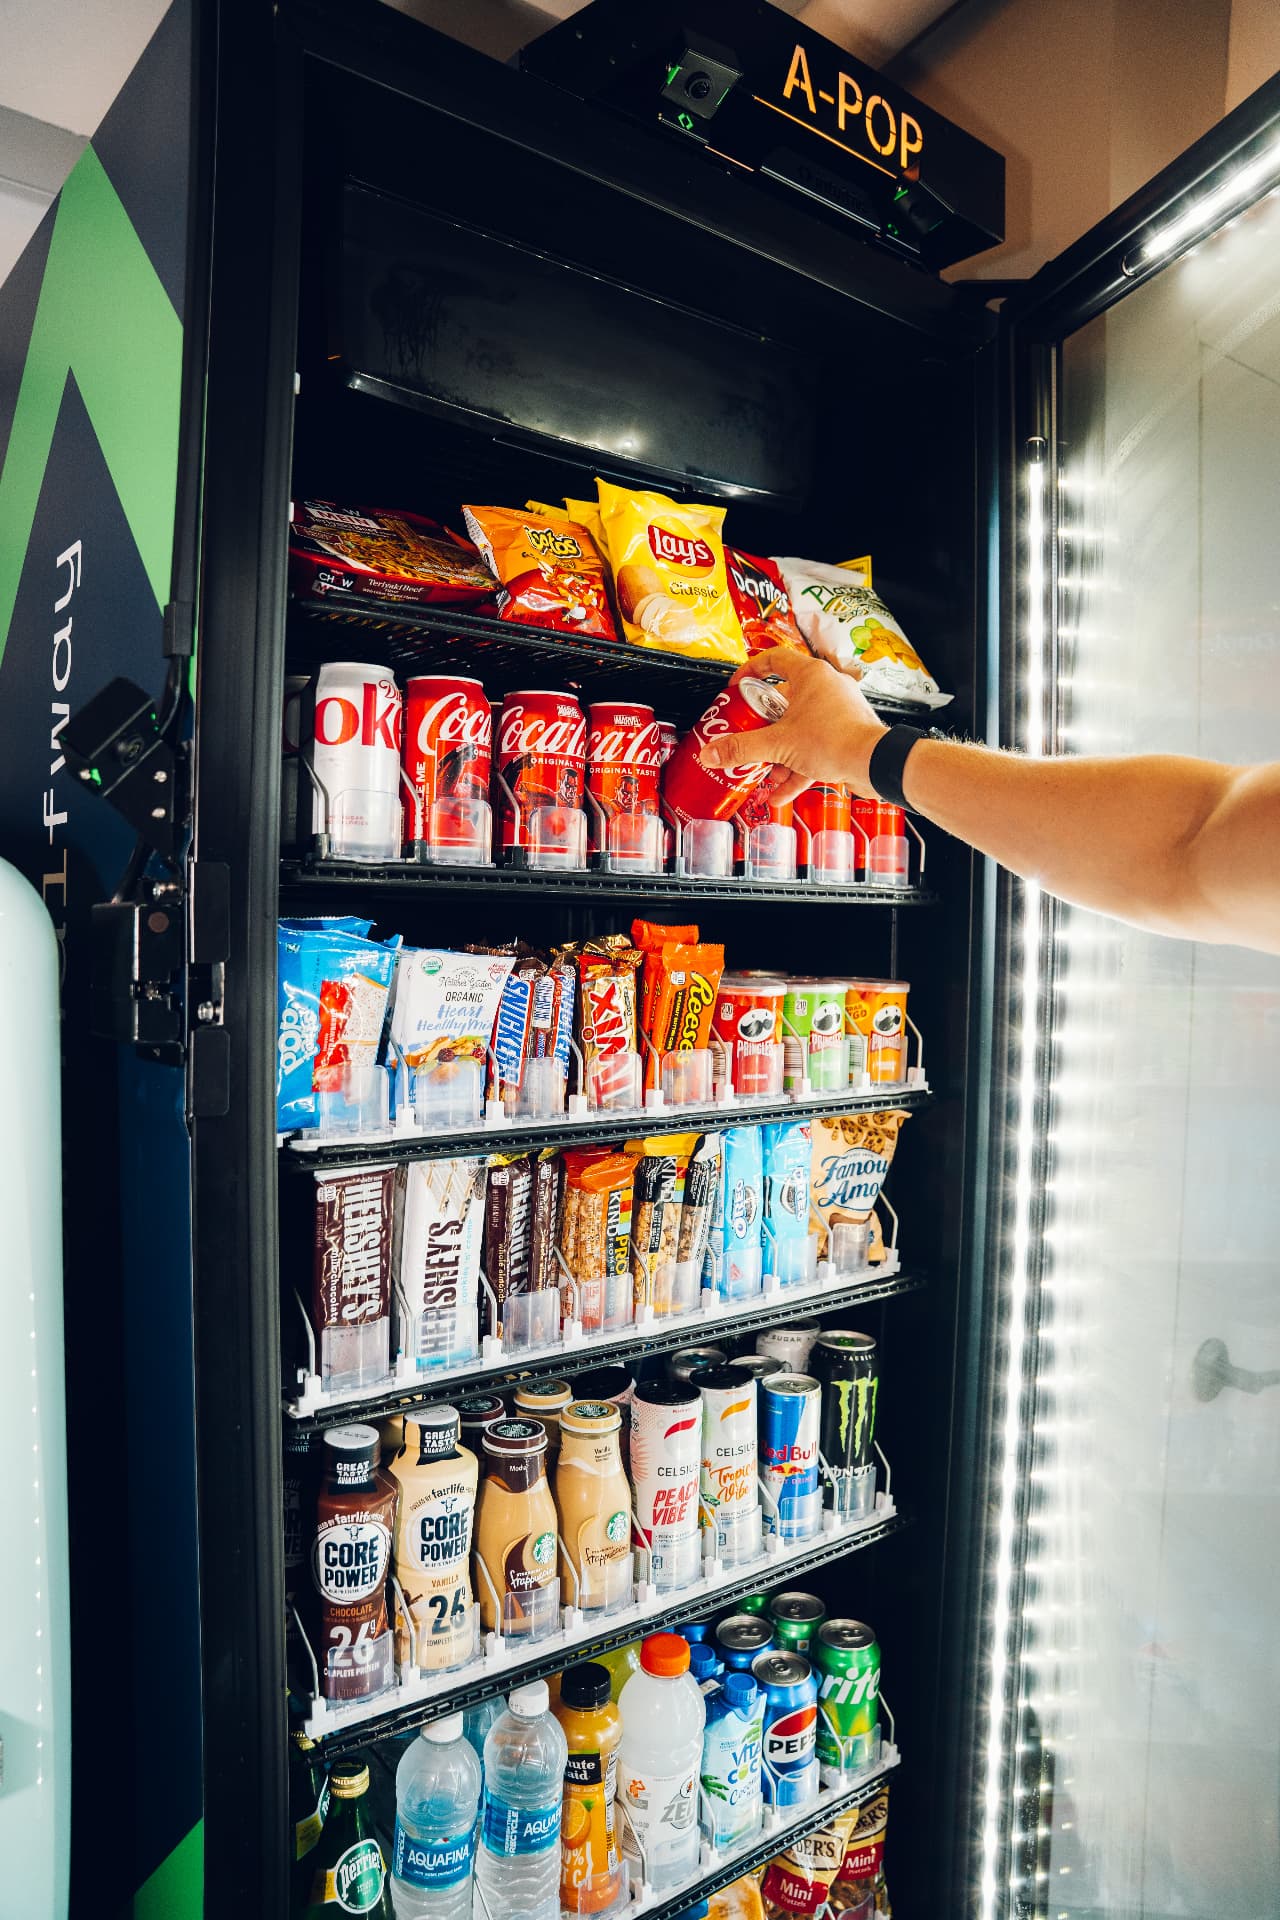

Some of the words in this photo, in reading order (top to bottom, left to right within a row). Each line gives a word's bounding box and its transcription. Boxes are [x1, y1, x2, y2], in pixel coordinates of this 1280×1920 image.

[783, 43, 924, 169] A-POP
[654, 528, 711, 568] Lay's
[667, 580, 720, 600] Classic
[729, 567, 789, 617] Doritos
[530, 756, 575, 768] ORIGINAL
[589, 766, 633, 775] ORIGINAL
[635, 767, 656, 777] TASTE
[445, 990, 484, 1004] ORGANIC
[437, 1003, 484, 1020] Heart
[495, 973, 531, 1084] SNICKERS
[660, 1155, 677, 1202] KIND
[813, 1155, 889, 1189] Famou
[817, 1179, 881, 1208] Amo
[607, 1190, 621, 1237] KIND
[733, 1178, 748, 1239] OREO
[341, 1180, 383, 1321] HERSHEY'S
[498, 1242, 506, 1268] whole
[615, 1234, 629, 1275] PRO
[329, 1273, 339, 1323] chocolate
[420, 1219, 464, 1355] HERSHEY'S
[497, 1268, 506, 1303] almonds
[772, 1334, 802, 1343] SUGAR
[424, 1427, 456, 1441] GREAT
[424, 1436, 457, 1449] TASTE
[761, 1440, 788, 1461] Red
[789, 1440, 817, 1461] Bull
[336, 1459, 370, 1473] GREAT
[431, 1483, 465, 1499] fairlife
[653, 1476, 699, 1508] PEACH
[716, 1485, 750, 1503] Vibe
[420, 1507, 470, 1542] CORE
[652, 1501, 688, 1527] VIBE
[324, 1534, 379, 1567] CORE
[420, 1531, 468, 1562] POWER
[324, 1560, 378, 1588] POWER
[431, 1574, 460, 1588] VANILLA
[329, 1601, 373, 1618] CHOCOLATE
[819, 1665, 880, 1706] rite
[566, 1758, 597, 1772] nute
[567, 1770, 591, 1782] aid
[510, 1809, 519, 1854] RECYCLE
[523, 1807, 562, 1837] AQUAF
[407, 1844, 470, 1872] AQUAFINA
[845, 1848, 876, 1871] Mini
[779, 1878, 814, 1902] Mini
